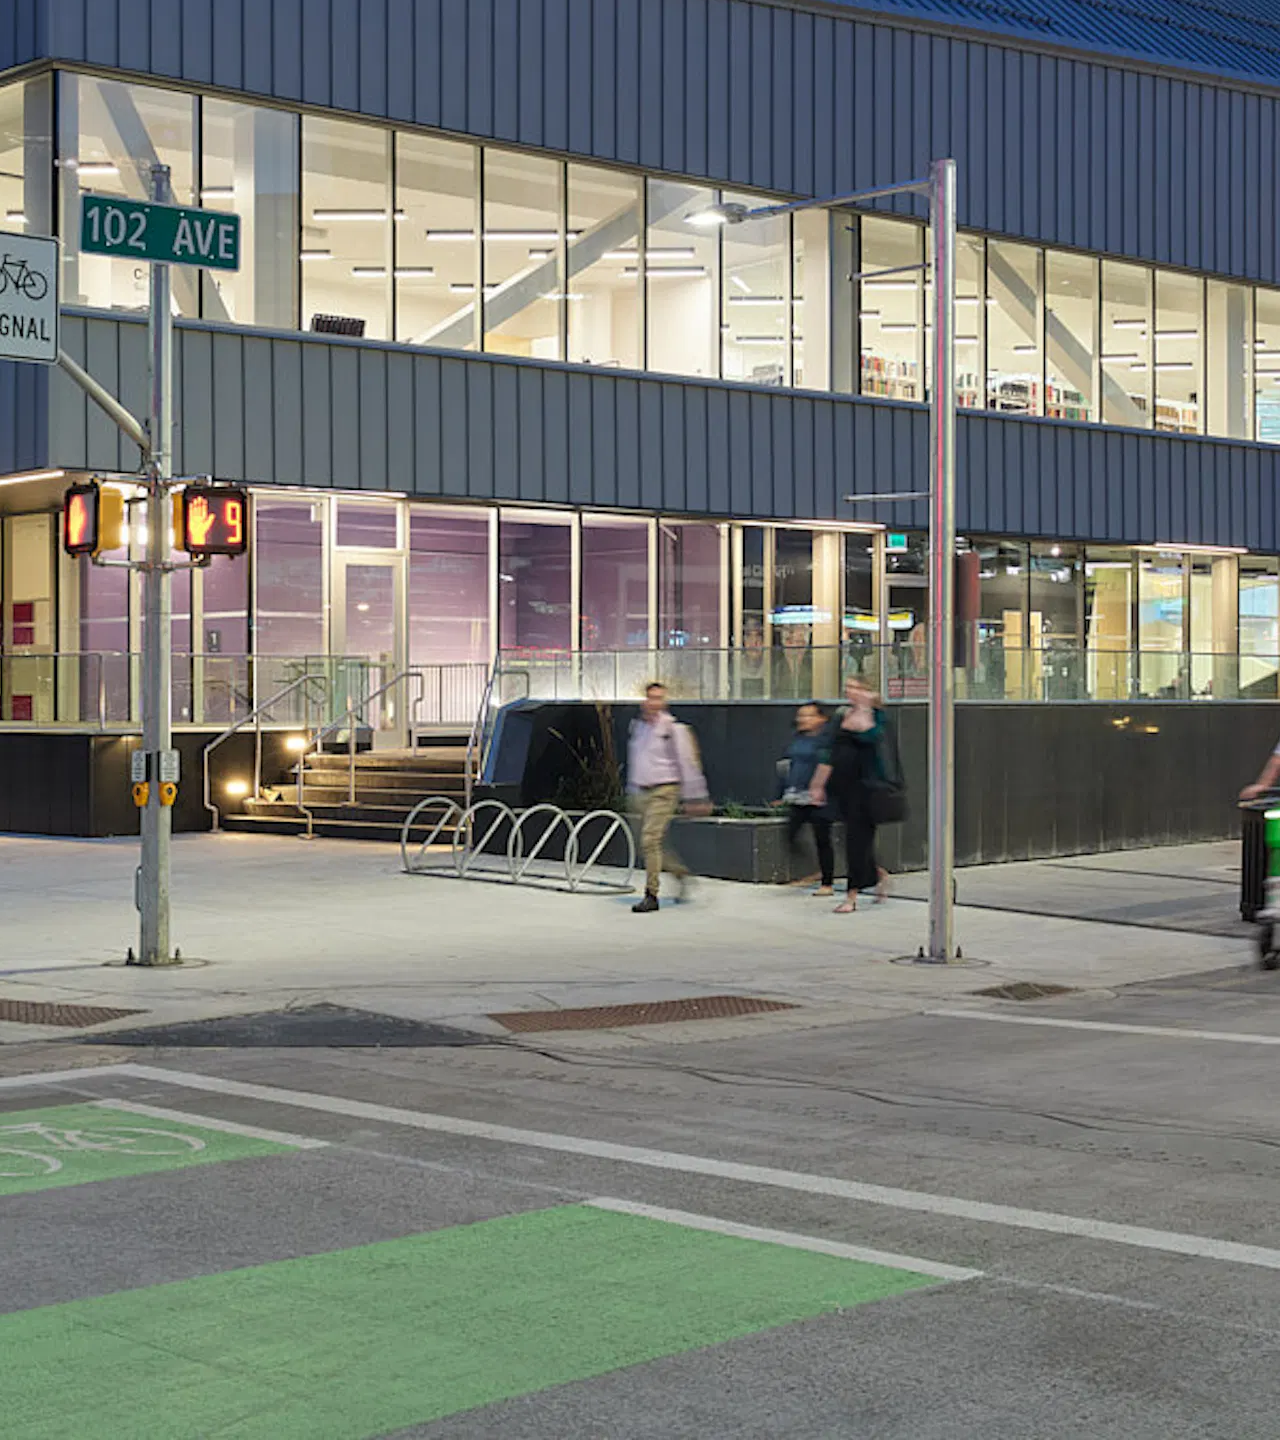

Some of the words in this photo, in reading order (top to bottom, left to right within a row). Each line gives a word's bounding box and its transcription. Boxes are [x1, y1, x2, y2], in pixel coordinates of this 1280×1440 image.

[86, 205, 147, 250] 102
[172, 216, 235, 260] AVE
[225, 500, 243, 544] 9
